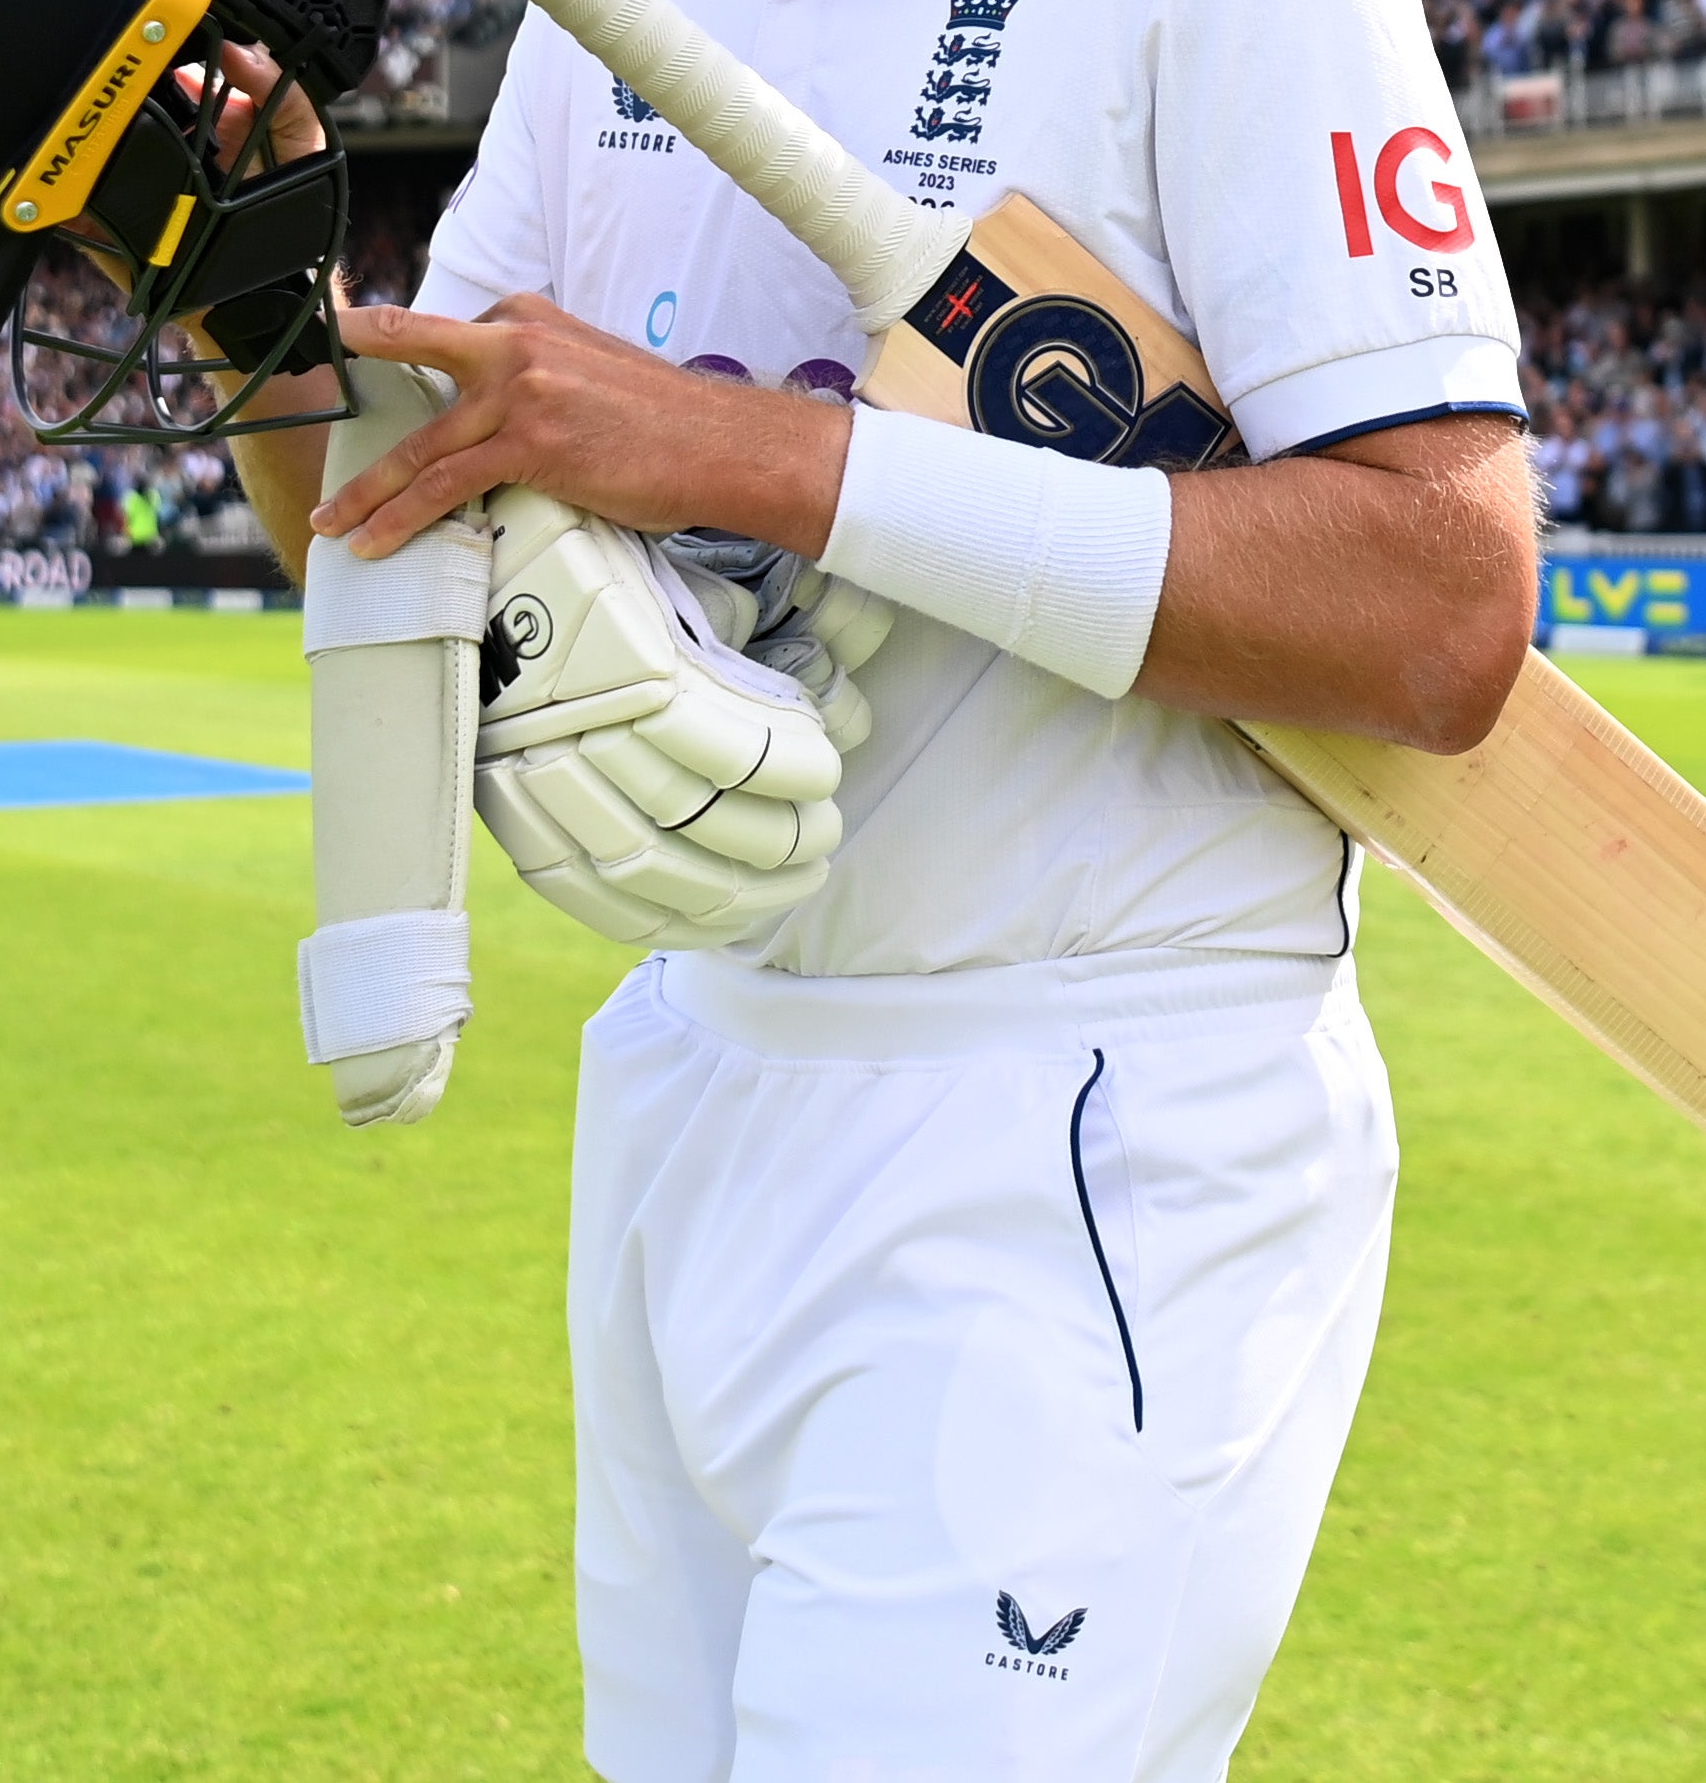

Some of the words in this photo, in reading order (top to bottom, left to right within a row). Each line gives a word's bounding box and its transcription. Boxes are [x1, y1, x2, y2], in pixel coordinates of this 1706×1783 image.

[40, 54, 142, 186] MASURI
[598, 130, 676, 153] CASTORE
[883, 149, 934, 167] ASHES
[938, 154, 997, 175] SERIES
[918, 172, 955, 191] 2023
[1330, 126, 1475, 258] IG
[1409, 267, 1458, 297] SB
[985, 1653, 1069, 1680] CASTORE
